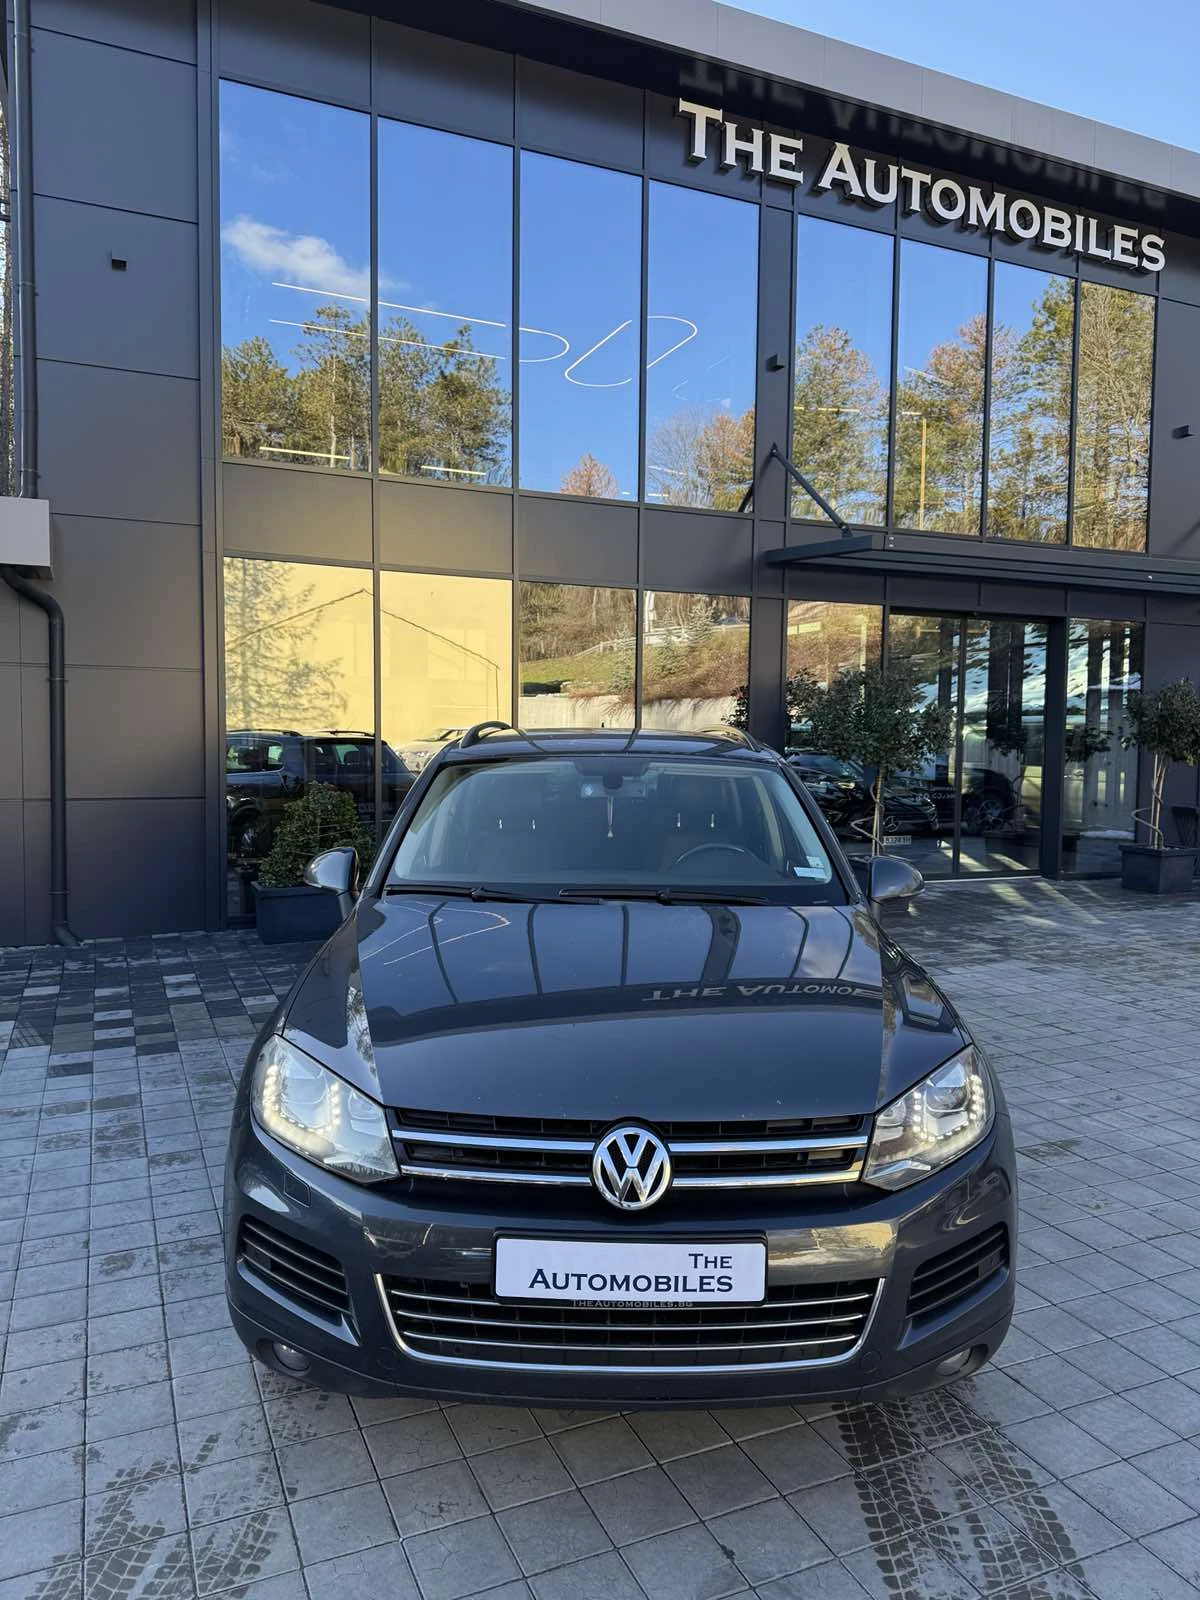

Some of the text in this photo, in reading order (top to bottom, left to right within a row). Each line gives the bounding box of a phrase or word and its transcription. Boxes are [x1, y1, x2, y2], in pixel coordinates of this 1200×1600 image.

[678, 98, 803, 183] THE
[818, 142, 1166, 272] AUTOMOBILES
[688, 1253, 733, 1269] THE
[528, 1268, 733, 1293] AUTOMOBILES
